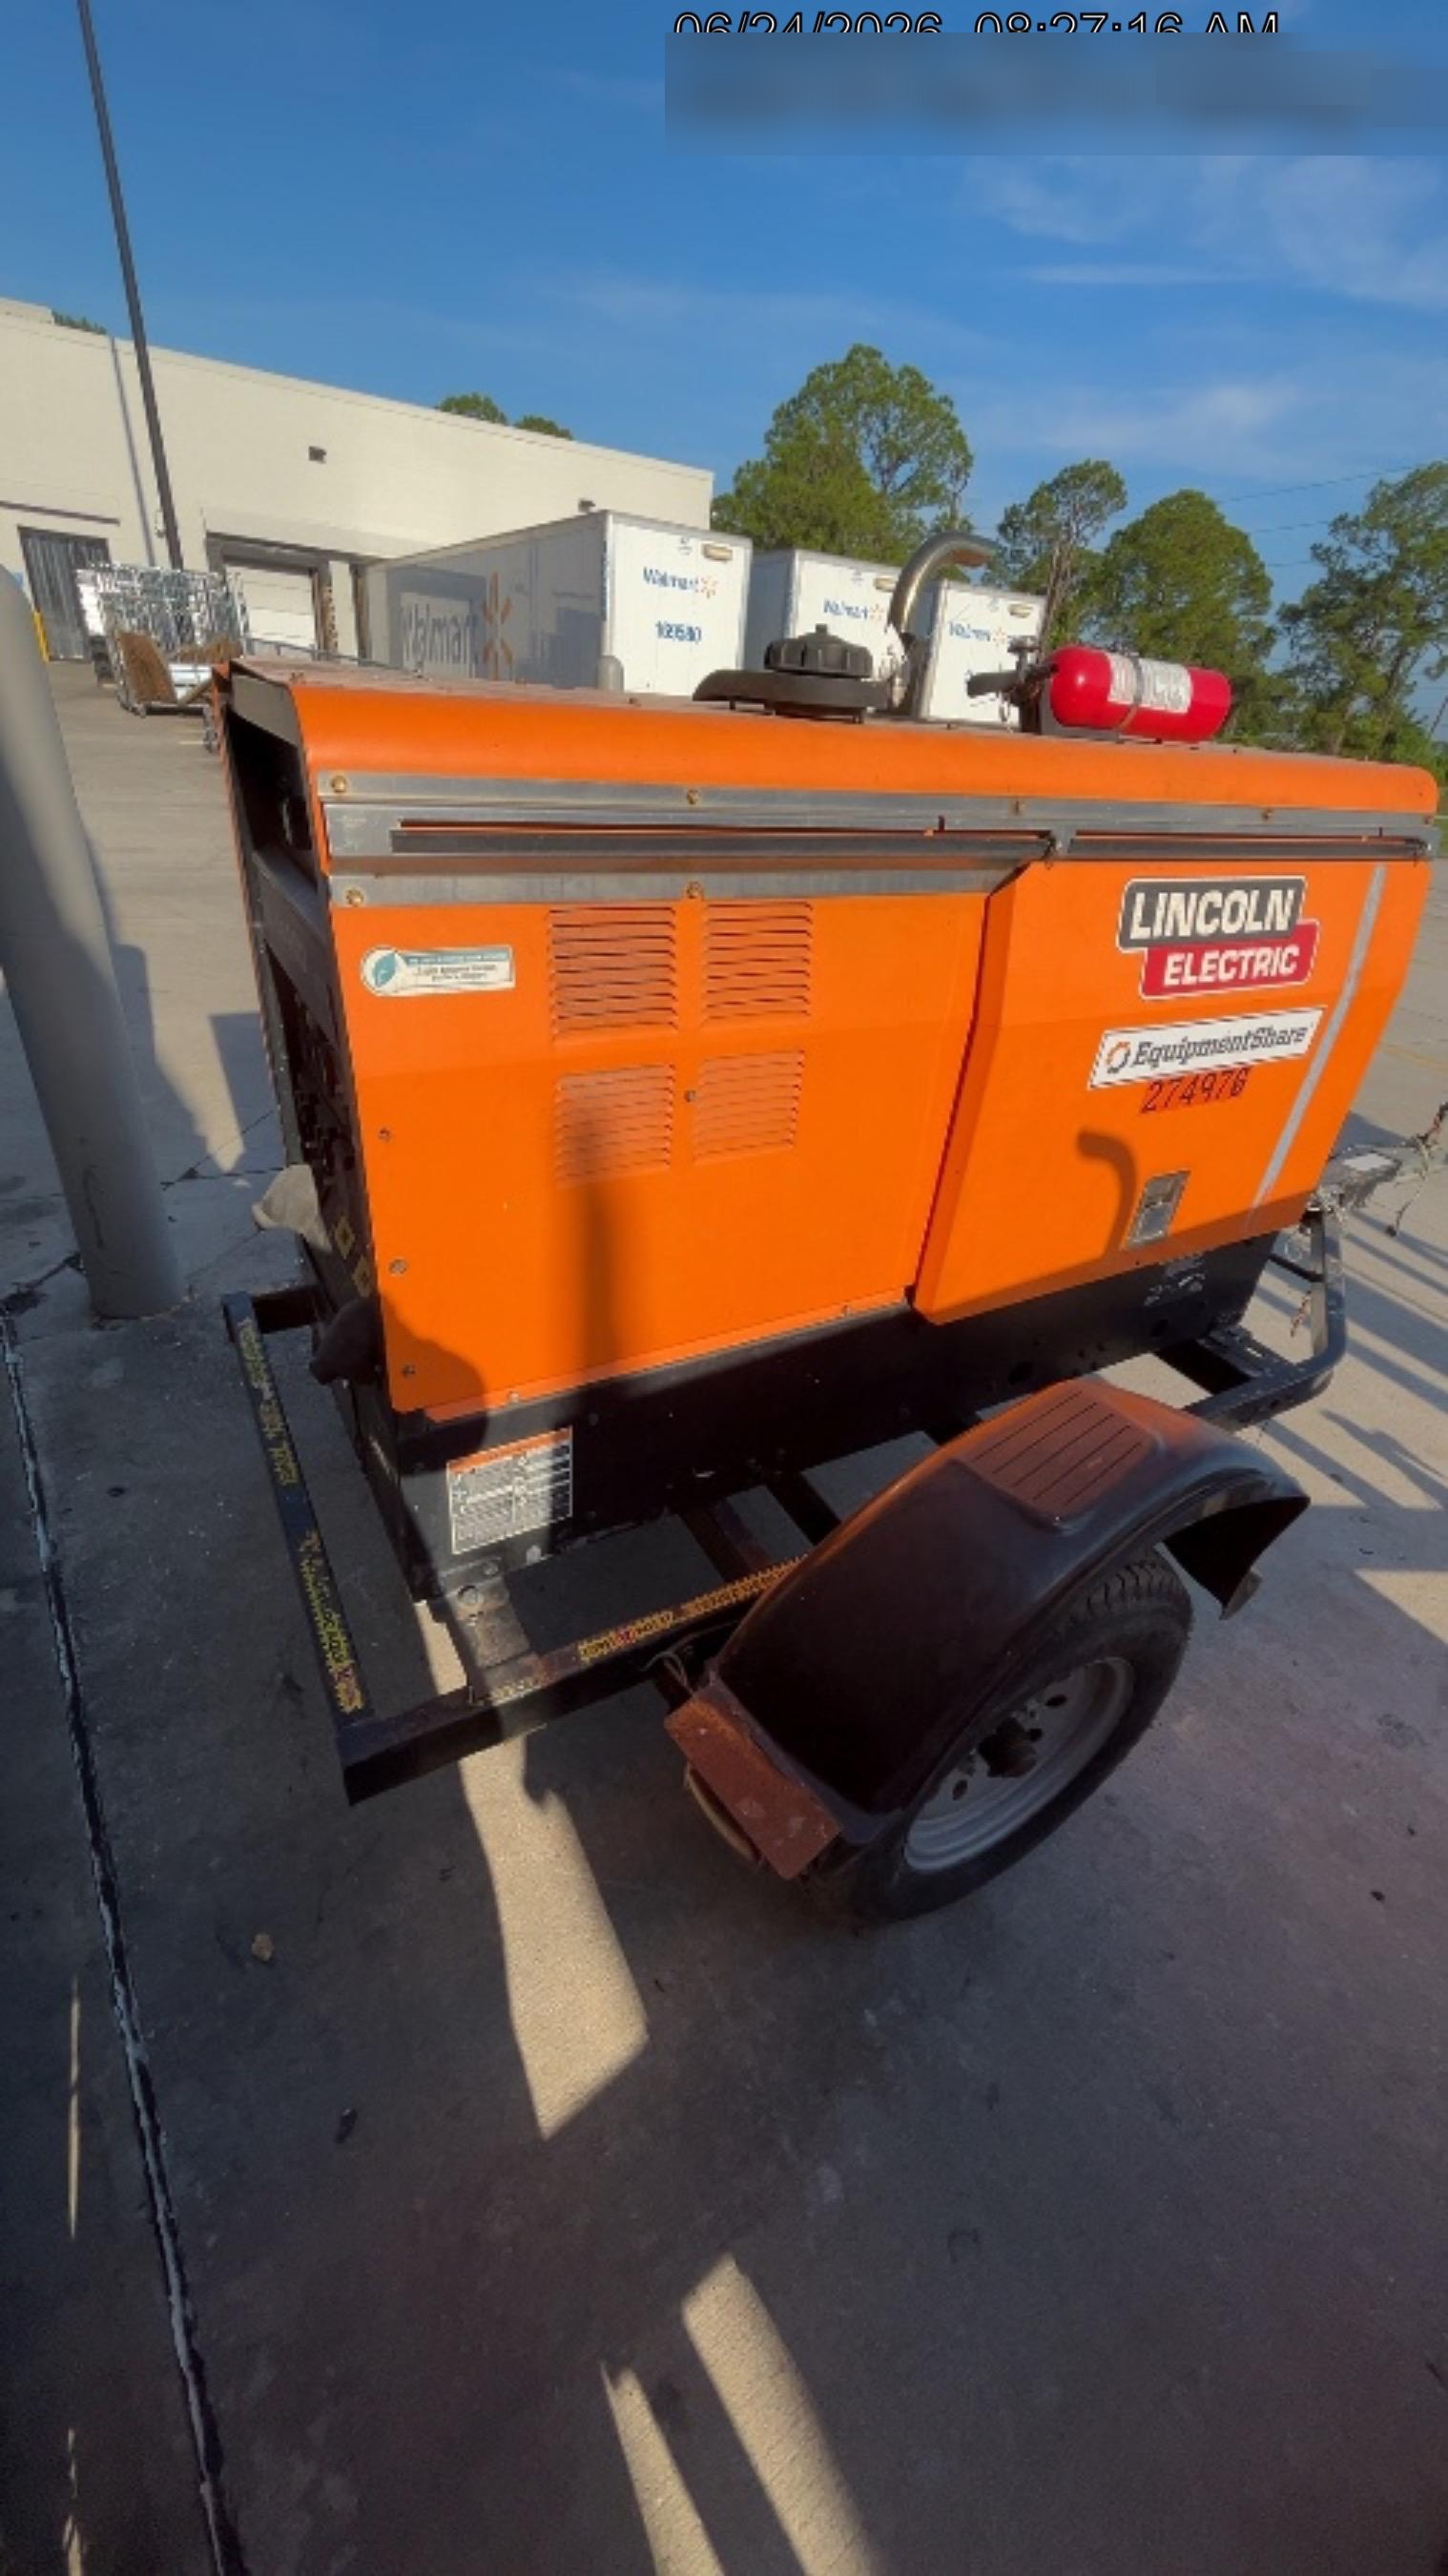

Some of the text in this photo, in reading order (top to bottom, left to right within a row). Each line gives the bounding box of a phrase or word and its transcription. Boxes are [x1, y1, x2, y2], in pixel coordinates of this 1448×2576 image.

[1129, 889, 1295, 940] LINCOLN
[1163, 945, 1300, 987] ELECTRIC
[1132, 1026, 1310, 1070] EquipmentShare
